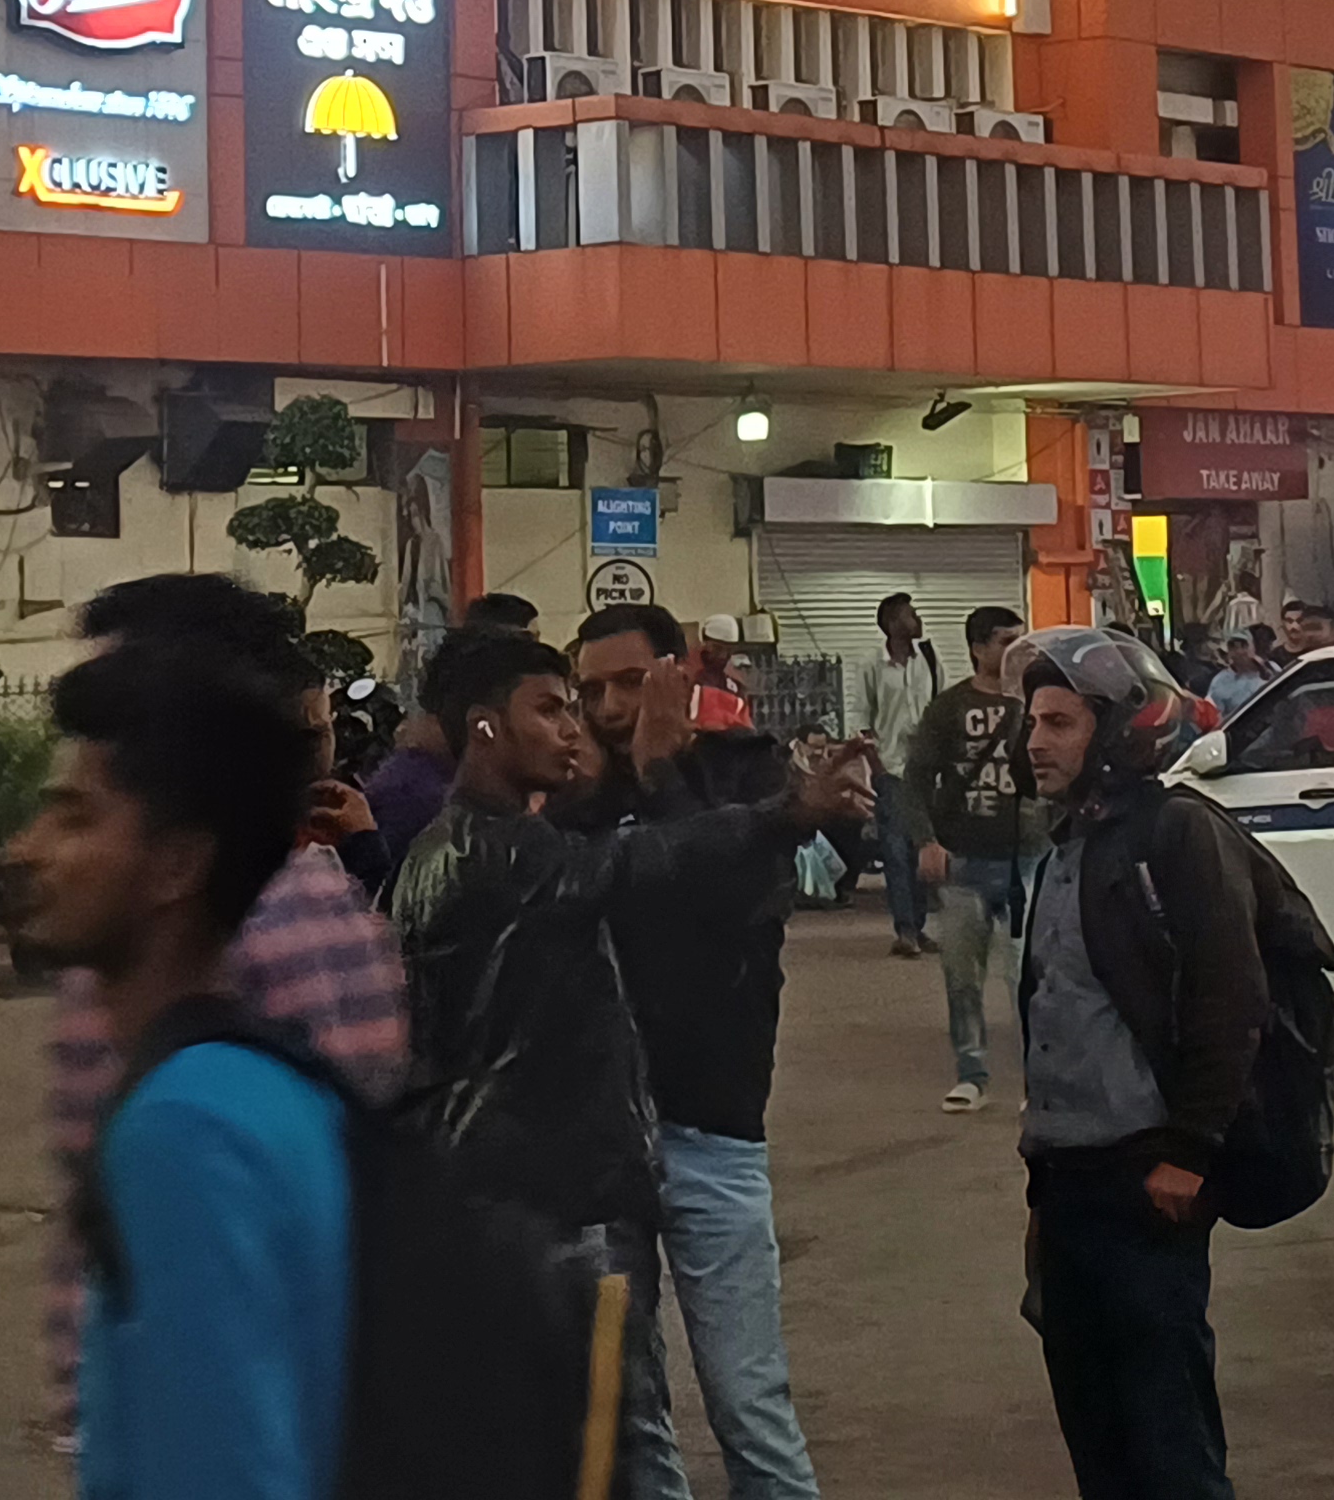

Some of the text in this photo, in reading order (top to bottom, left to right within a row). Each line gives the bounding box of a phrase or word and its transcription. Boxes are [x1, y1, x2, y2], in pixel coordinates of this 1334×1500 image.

[1182, 412, 1221, 443] JAN
[1199, 469, 1281, 492] TAKE AWAY
[608, 520, 641, 535] POINT
[612, 573, 630, 586] NO
[595, 587, 628, 602] PICK
